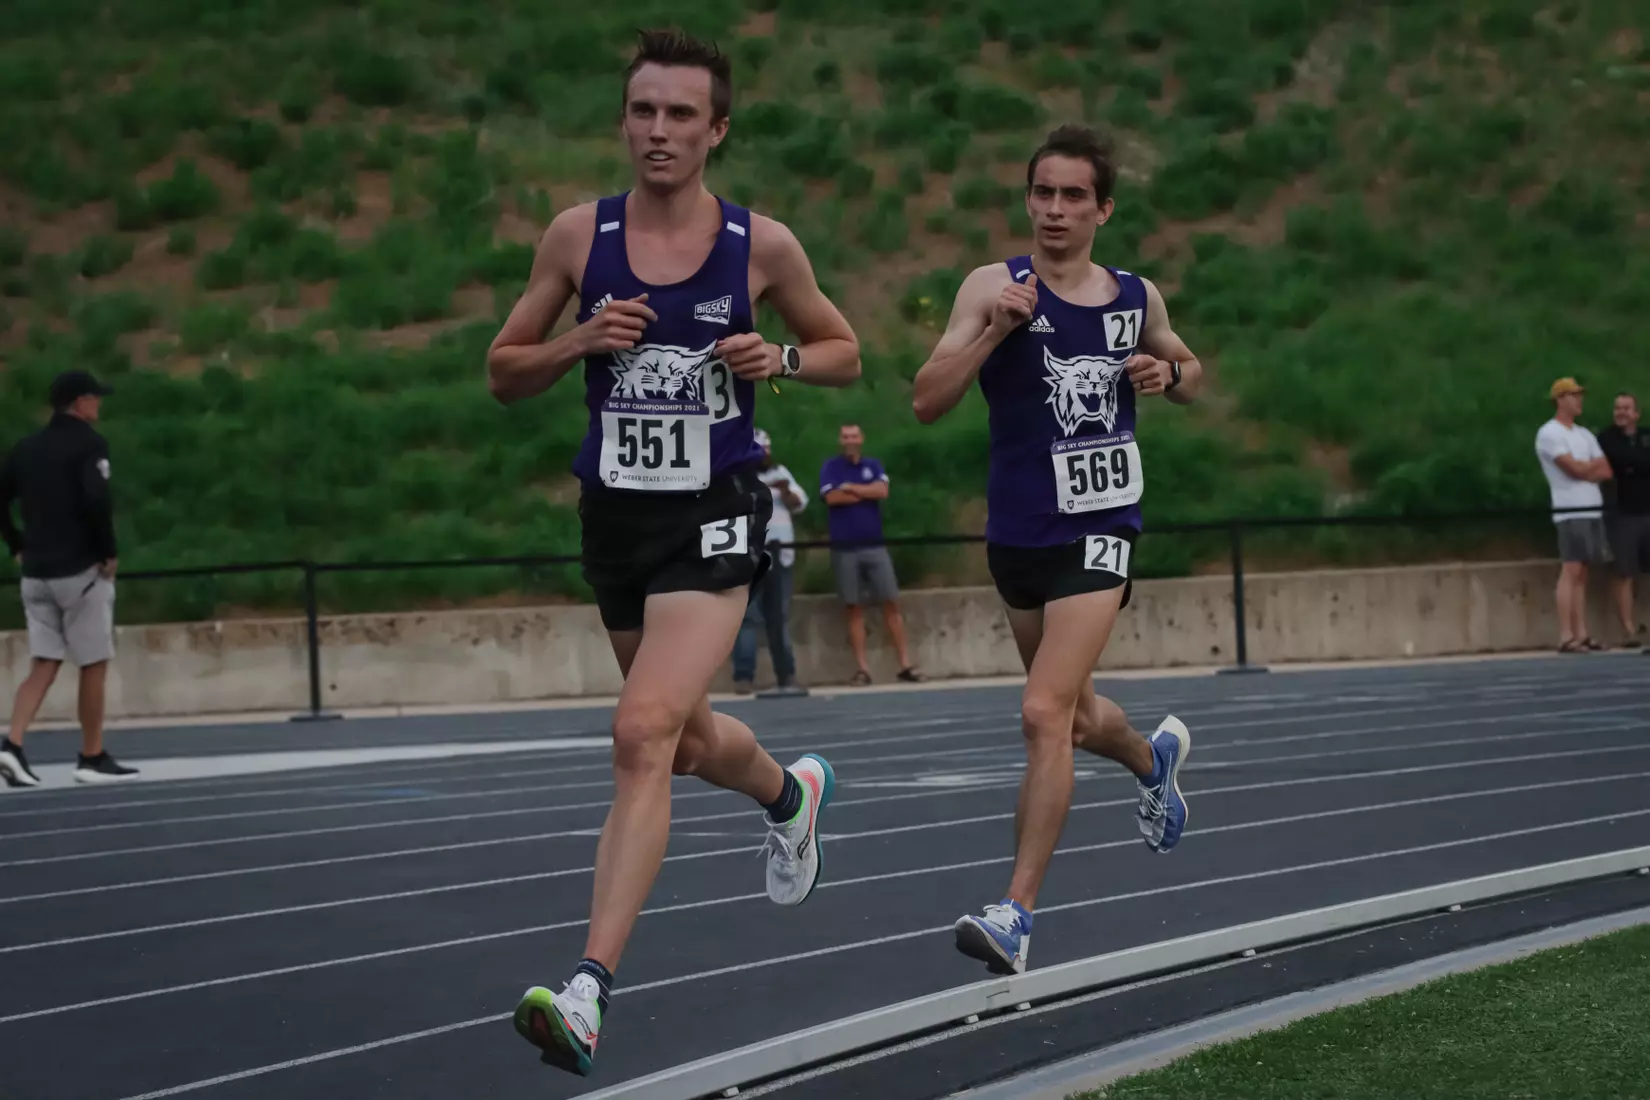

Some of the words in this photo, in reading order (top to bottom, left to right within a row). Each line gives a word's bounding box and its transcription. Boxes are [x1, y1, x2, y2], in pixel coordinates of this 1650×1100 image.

[1028, 325, 1055, 333] adidas
[1110, 313, 1136, 348] 21
[632, 403, 682, 411] CHAMPIONSHIPS
[711, 362, 730, 420] 3
[617, 418, 690, 469] 551
[1078, 436, 1120, 447] CHAMPIONSHIPS
[1066, 448, 1129, 496] 569
[710, 516, 738, 552] 3
[1090, 537, 1122, 572] 21
